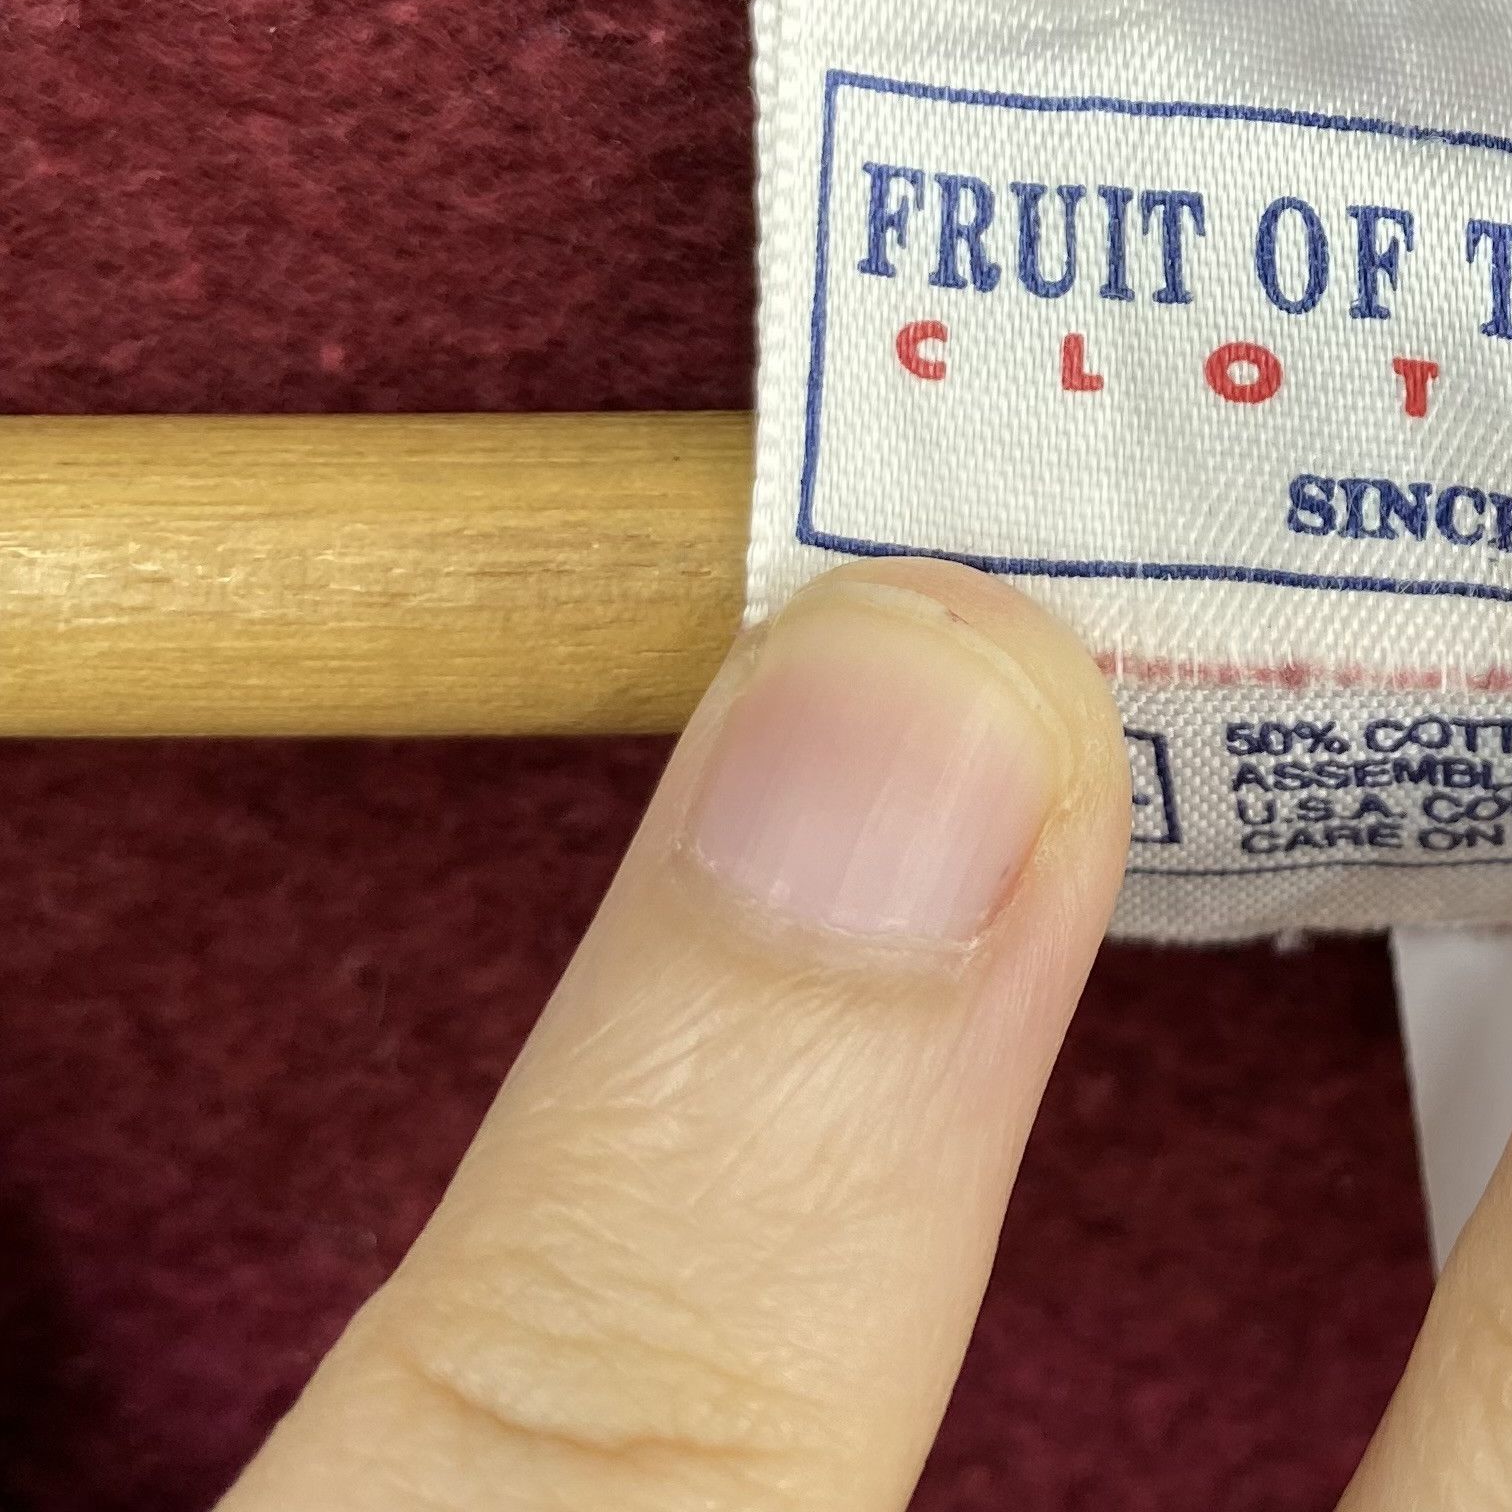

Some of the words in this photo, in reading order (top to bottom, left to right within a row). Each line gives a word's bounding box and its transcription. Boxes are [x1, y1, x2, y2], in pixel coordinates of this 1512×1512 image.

[857, 160, 1207, 304] FRUIT
[1255, 196, 1415, 320] OF
[1226, 720, 1350, 756] 50%
[1237, 792, 1408, 825] U.S.A.
[1241, 822, 1402, 854] CARE
[1418, 824, 1504, 851] ON
